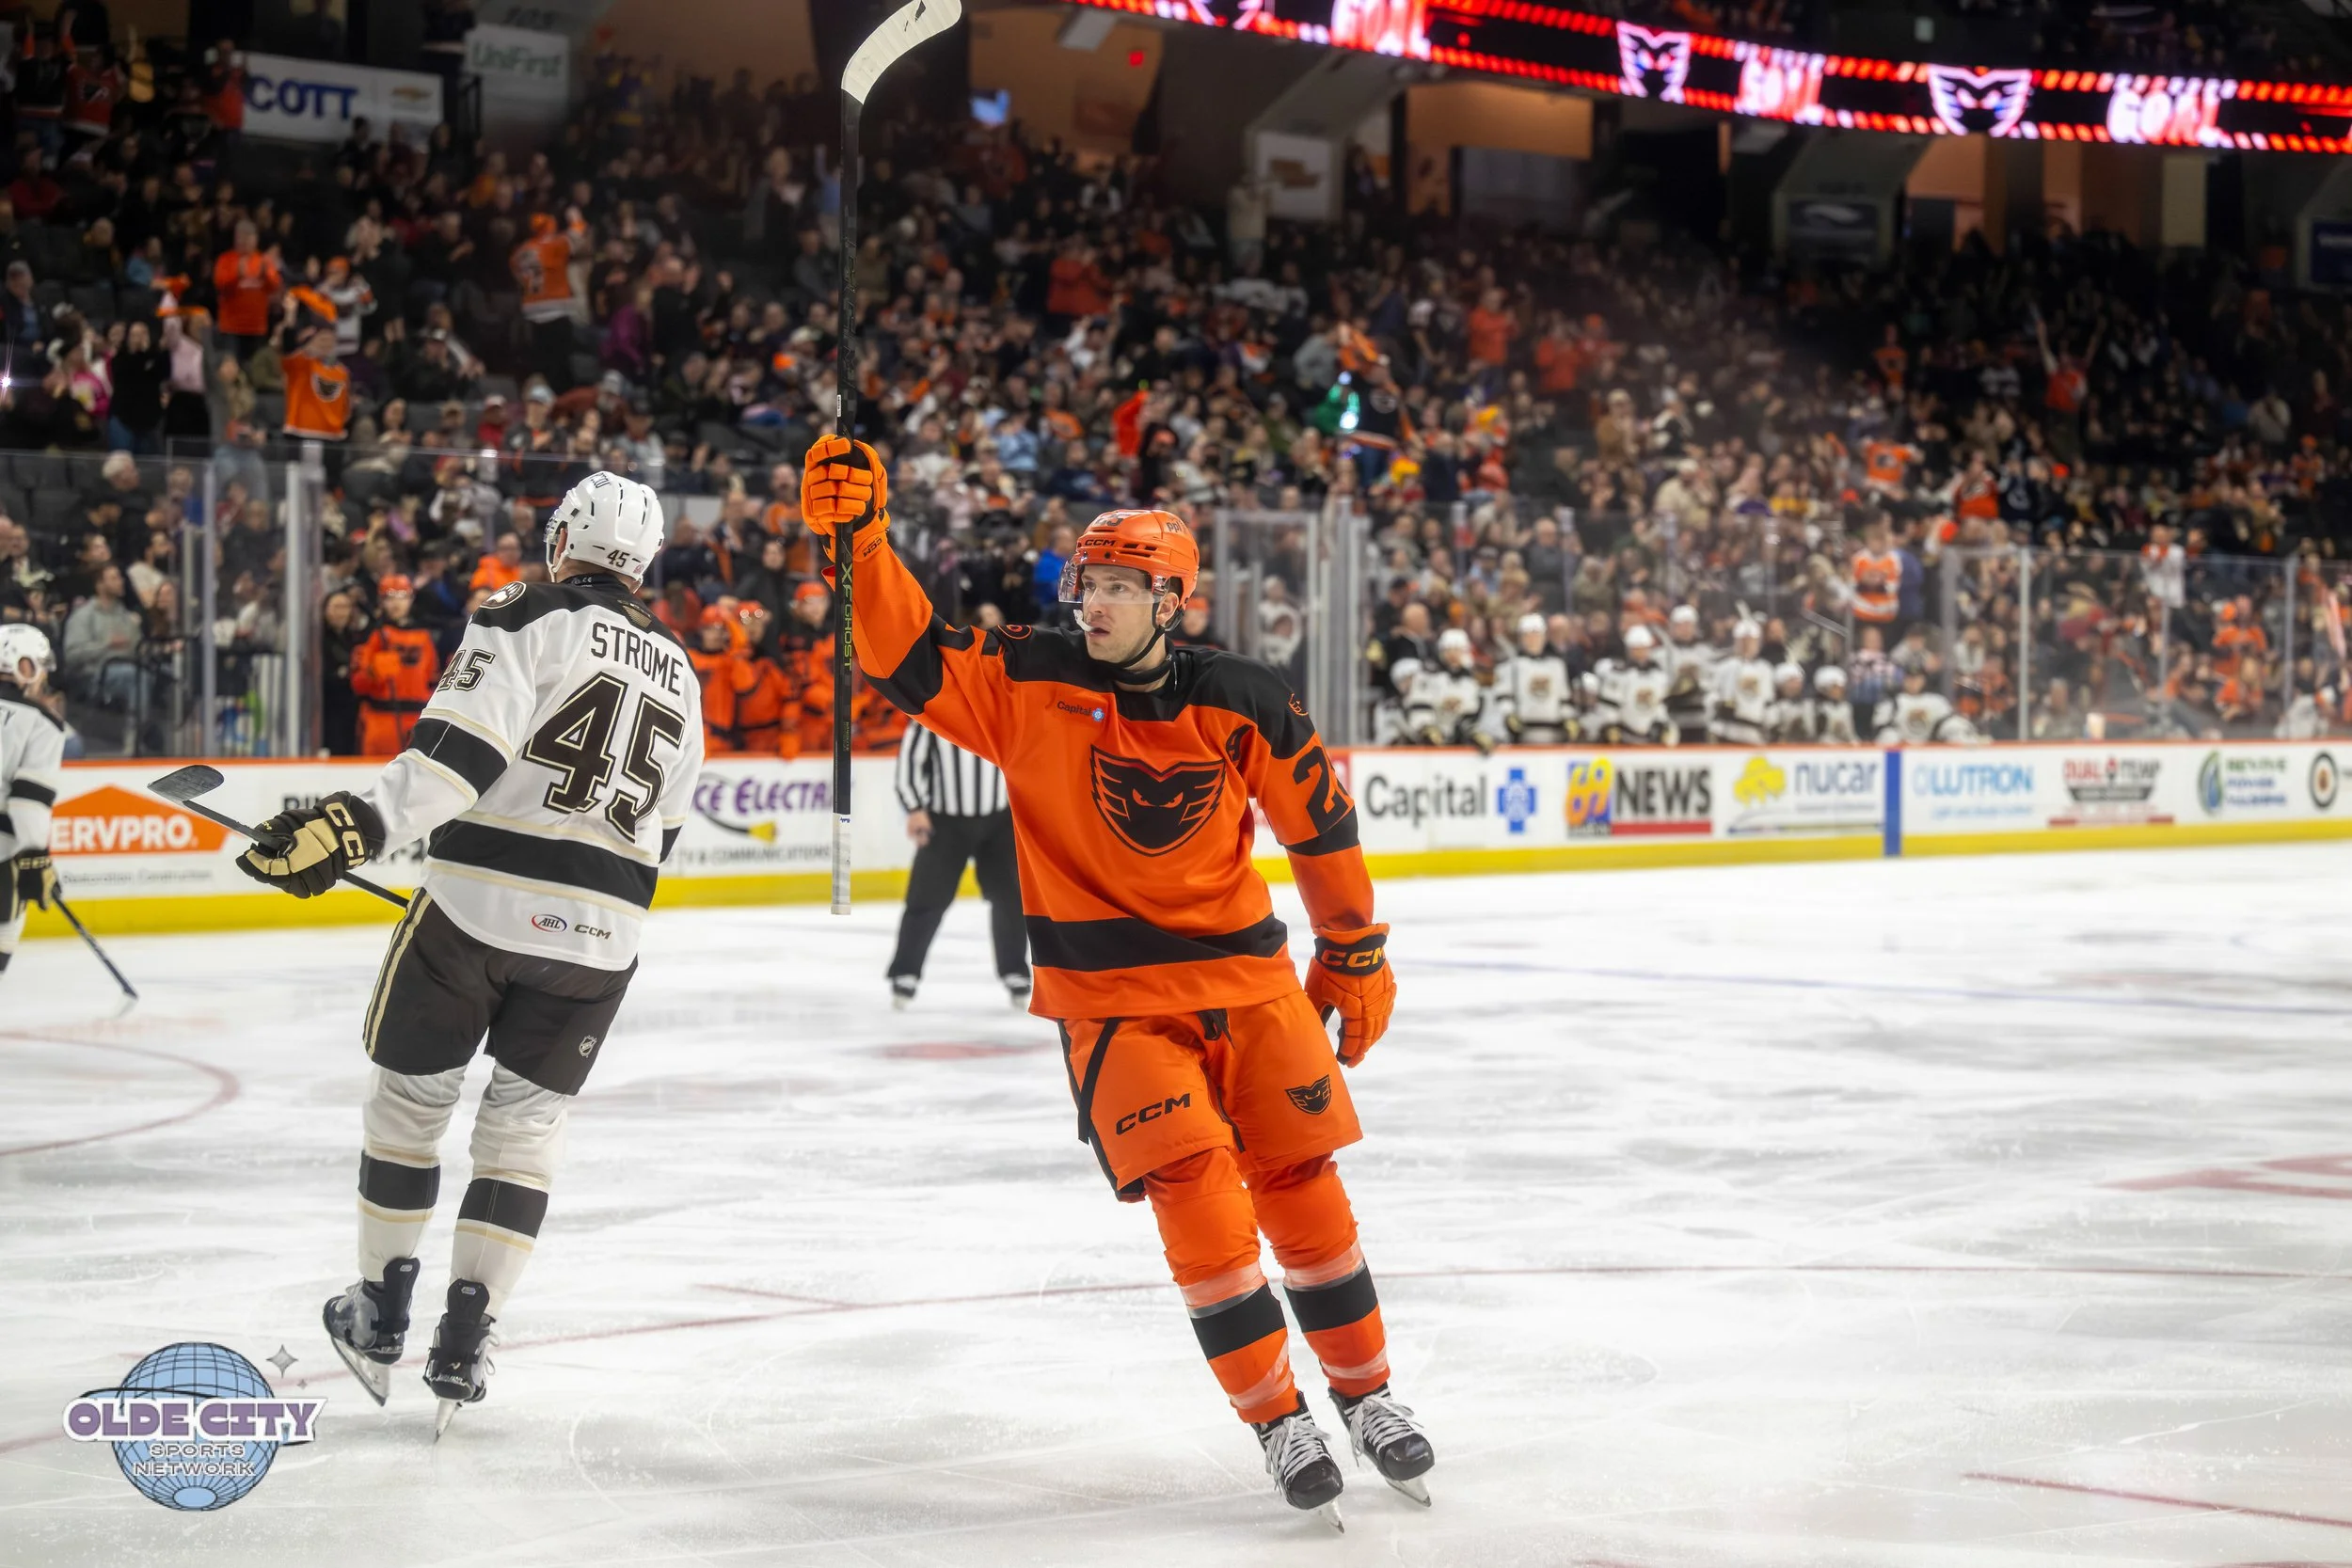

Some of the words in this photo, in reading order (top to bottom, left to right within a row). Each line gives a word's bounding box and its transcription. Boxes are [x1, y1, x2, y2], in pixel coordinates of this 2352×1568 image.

[473, 42, 562, 78] UniFirst
[607, 548, 630, 568] 45
[862, 537, 882, 558] CCM
[844, 604, 853, 671] GHOST
[437, 648, 496, 692] 45
[590, 621, 684, 696] STROME
[1057, 700, 1092, 715] Capital
[521, 671, 686, 845] 45
[2064, 757, 2104, 781] DUAL
[1565, 755, 1614, 825] 69
[1616, 768, 1712, 816] NEWS
[1795, 760, 1878, 796] nucar
[1365, 773, 1486, 828] Capital
[538, 918, 561, 929] AHL
[574, 924, 612, 940] CCM
[1116, 1093, 1190, 1136] CCM
